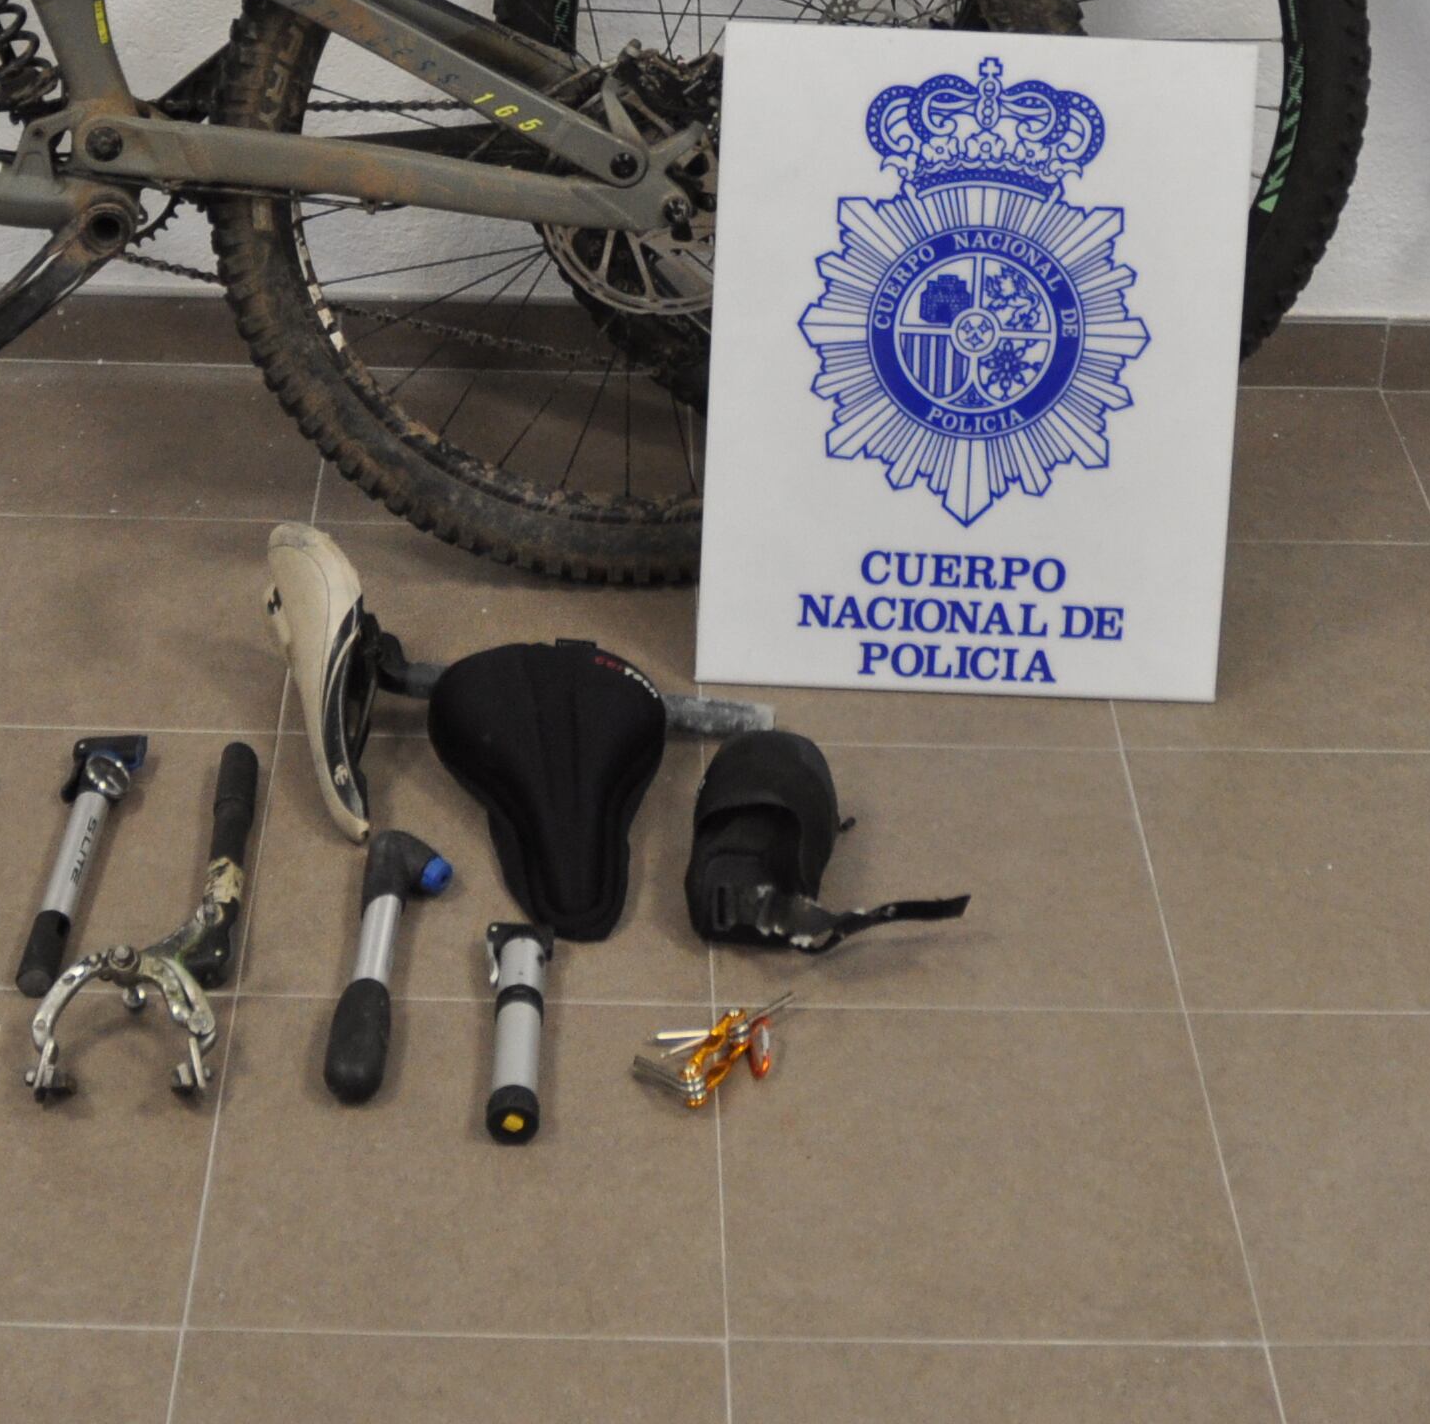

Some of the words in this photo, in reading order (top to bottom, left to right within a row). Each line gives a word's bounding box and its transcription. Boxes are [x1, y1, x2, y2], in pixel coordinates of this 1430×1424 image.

[473, 91, 544, 133] 165
[873, 244, 936, 330] CUERPO
[952, 231, 1066, 292] NACIONAL
[1060, 308, 1079, 339] DE
[924, 405, 1025, 433] POLICIA
[860, 549, 1067, 594] CUERPO
[796, 593, 1050, 640] NACIONAL
[1060, 604, 1125, 642] DE
[857, 641, 1058, 684] POLICIA
